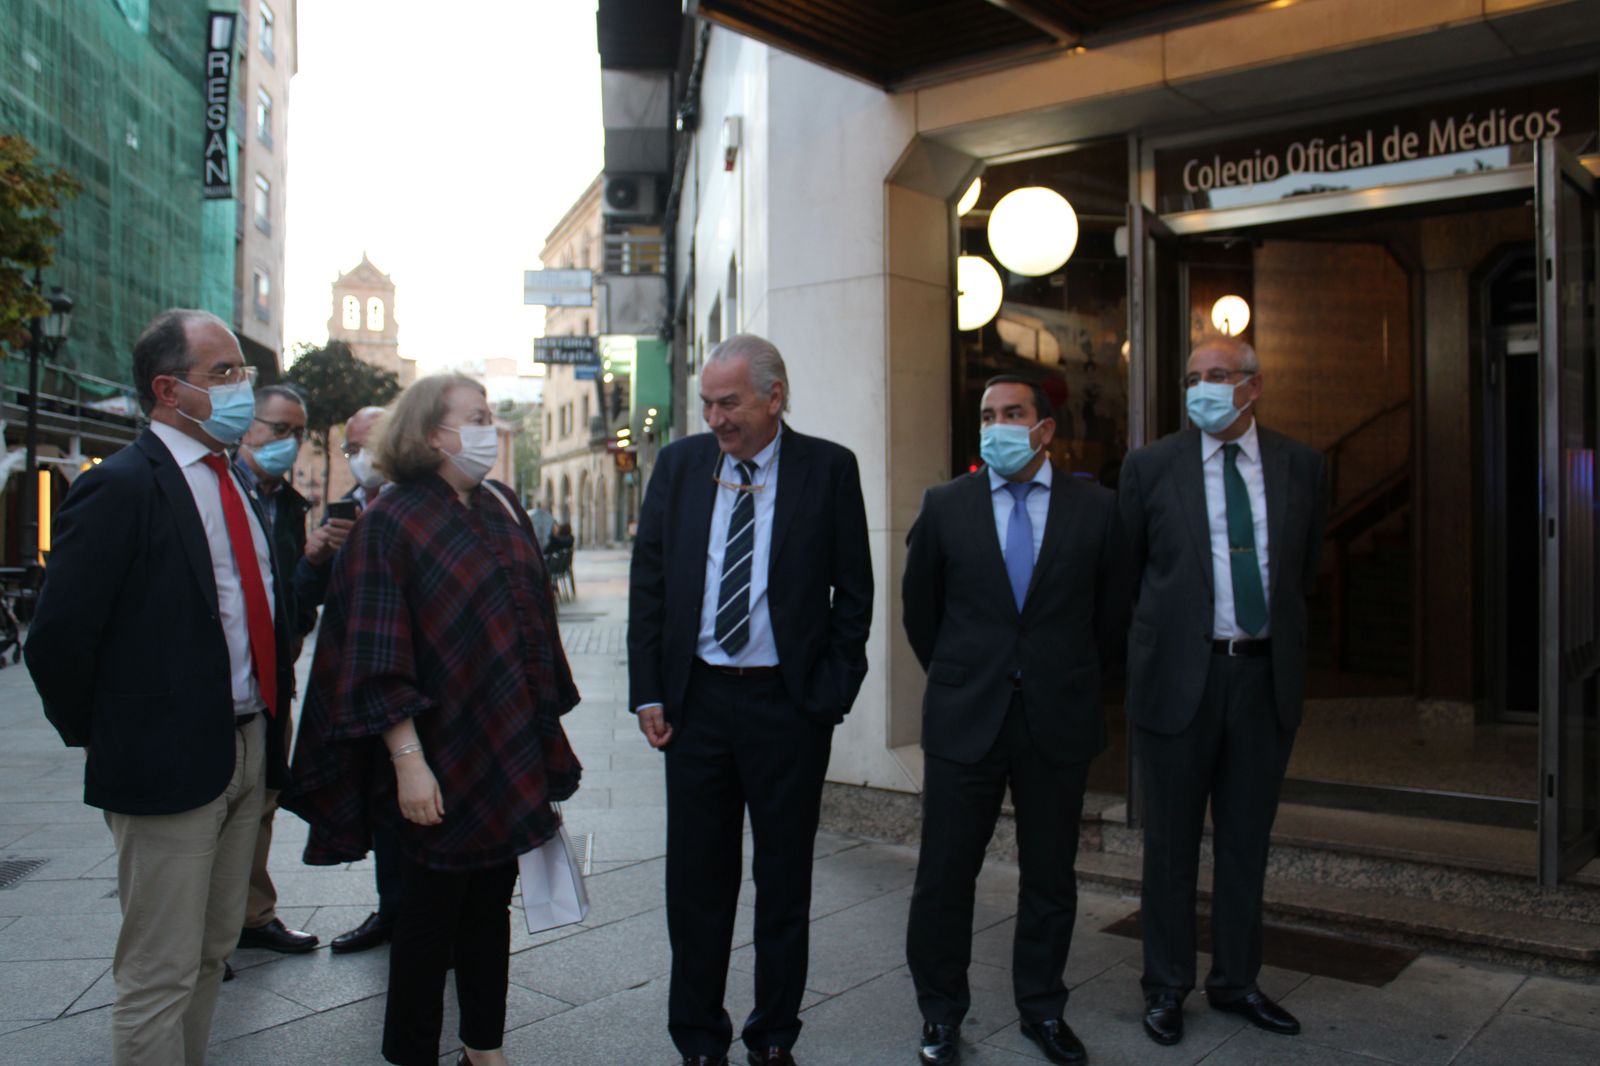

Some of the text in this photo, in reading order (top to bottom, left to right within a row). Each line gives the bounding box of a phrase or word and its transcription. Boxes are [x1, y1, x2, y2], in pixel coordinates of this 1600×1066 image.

[206, 52, 230, 185] RESAN
[1183, 108, 1561, 193] Colegio Oficial de Médicos
